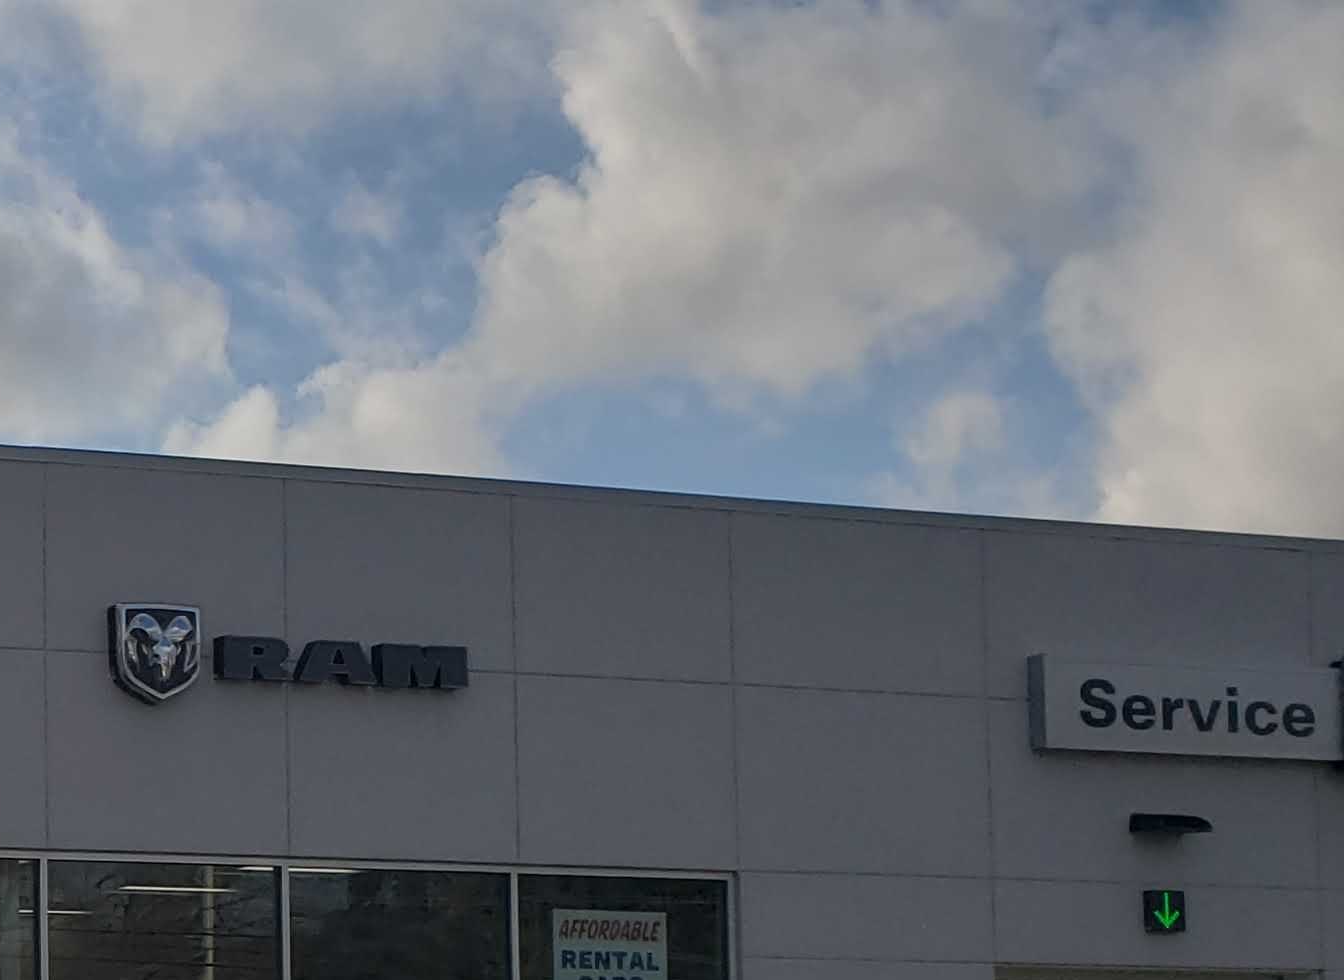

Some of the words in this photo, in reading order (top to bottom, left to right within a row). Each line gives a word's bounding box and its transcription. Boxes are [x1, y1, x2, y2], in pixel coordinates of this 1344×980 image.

[213, 634, 470, 690] RAM
[1079, 678, 1316, 738] Service
[559, 919, 661, 943] AFFORDABLE
[562, 950, 660, 972] RENTAL
